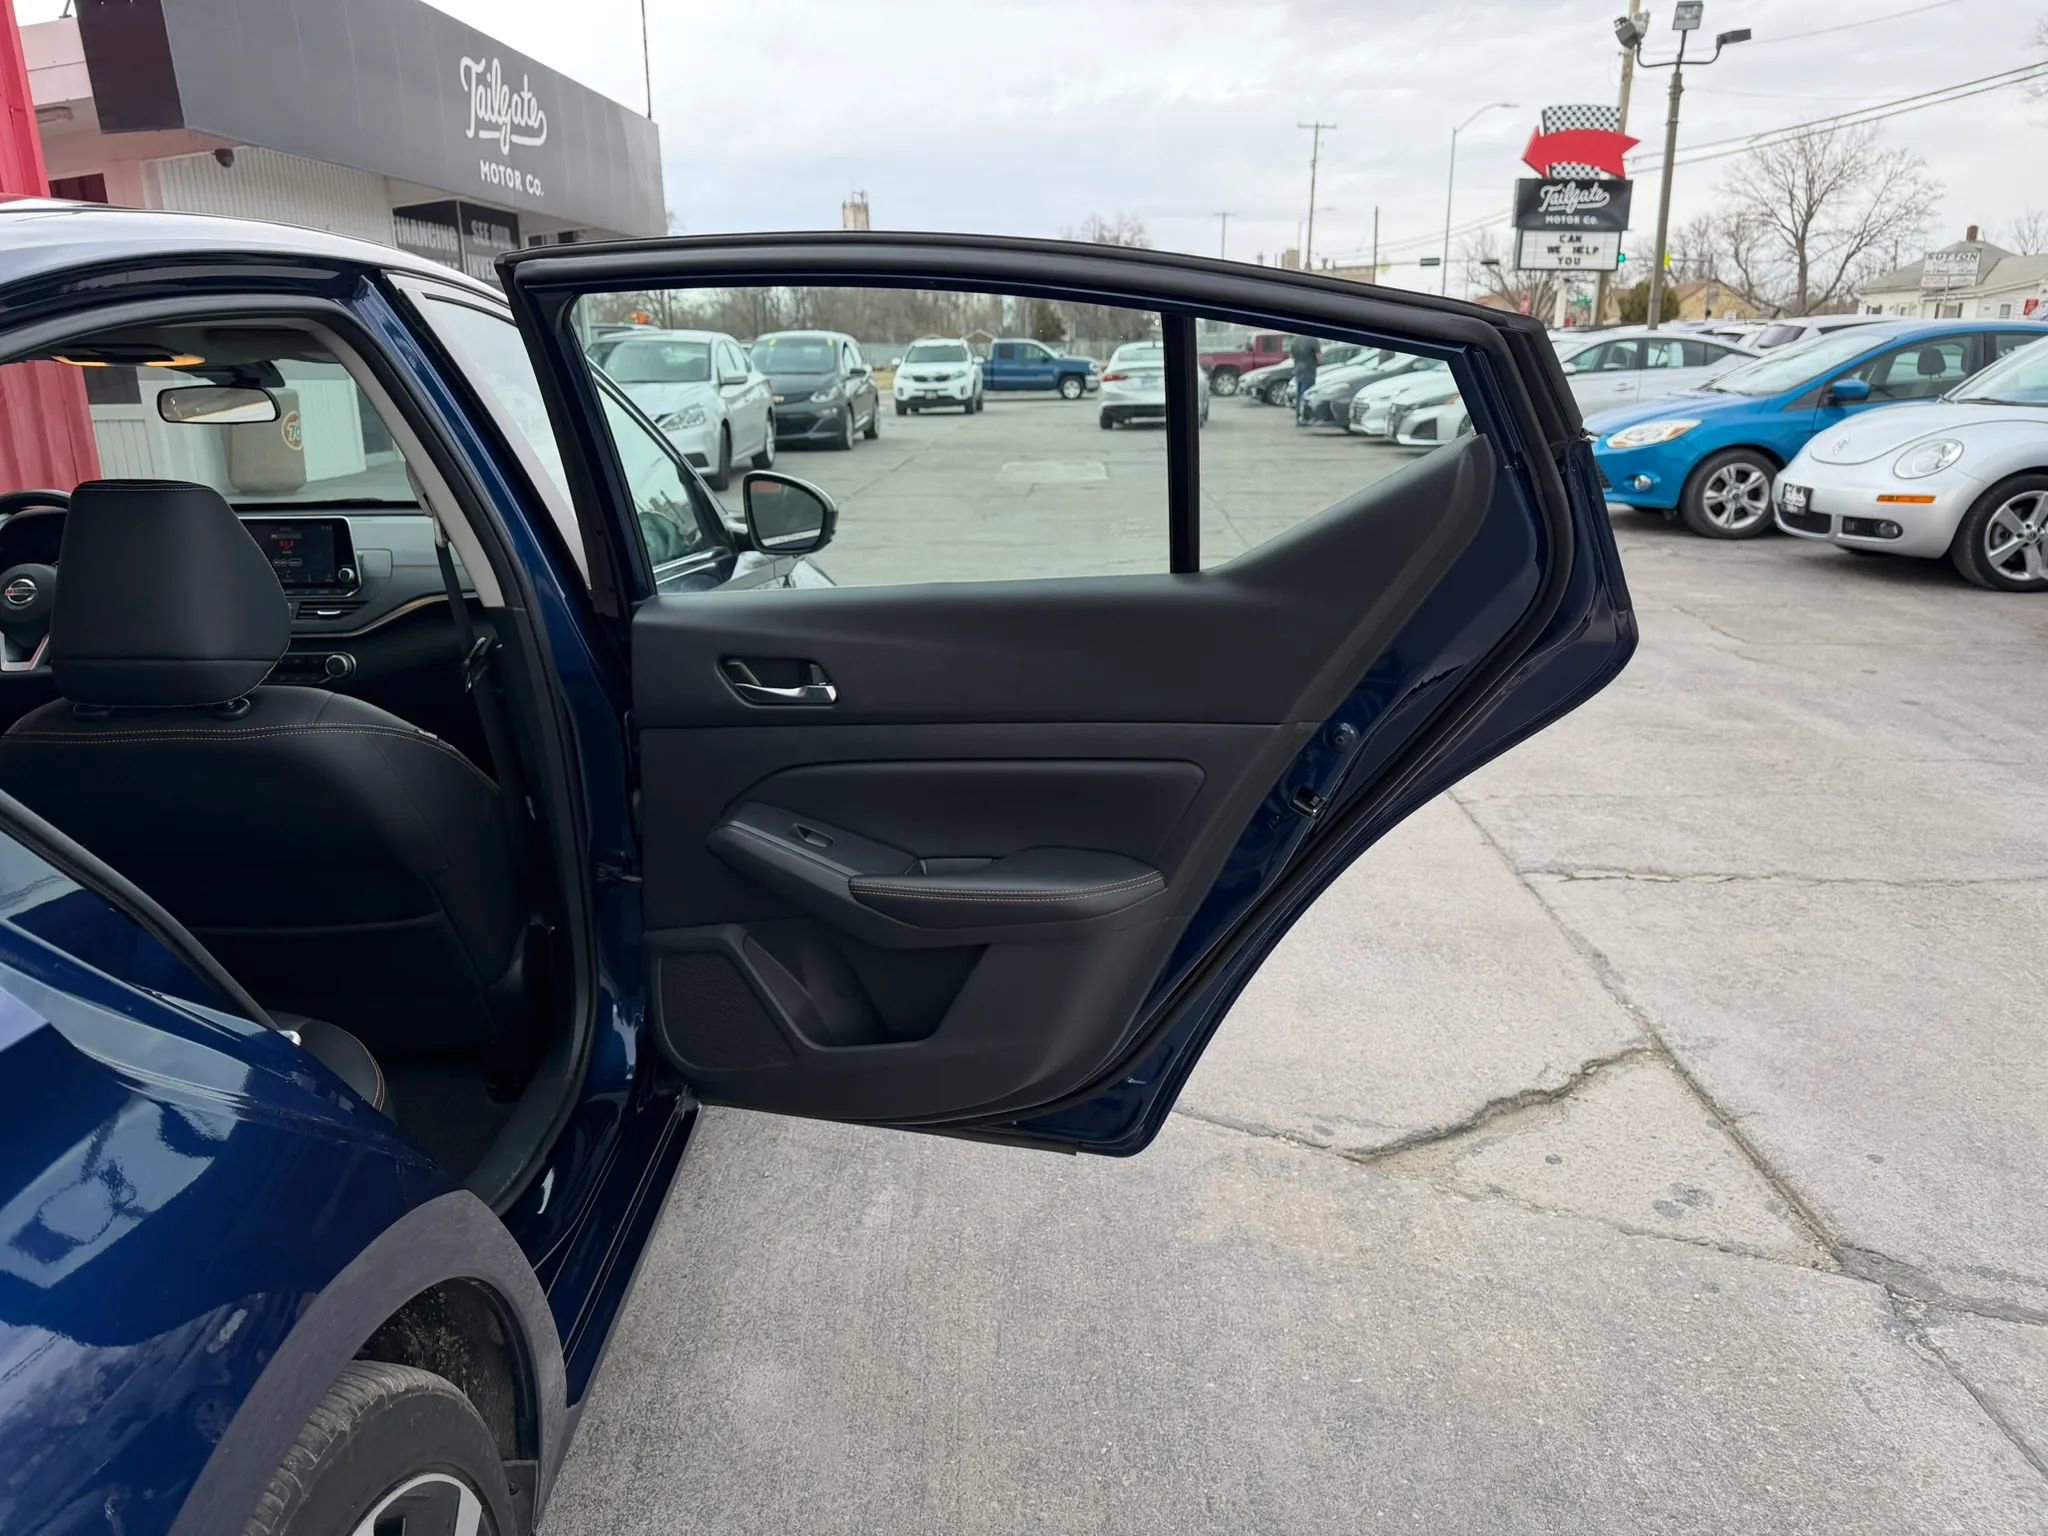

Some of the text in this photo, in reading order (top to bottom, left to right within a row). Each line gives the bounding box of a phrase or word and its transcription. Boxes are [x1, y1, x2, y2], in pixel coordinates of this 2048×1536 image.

[460, 56, 547, 155] Tailgate
[480, 160, 522, 191] MOTOR
[1538, 181, 1610, 214] Tailgate
[1545, 214, 1580, 225] MOTOR
[395, 215, 459, 252] INANCING
[1559, 234, 1582, 243] CAN
[1547, 245, 1599, 255] WE HELP
[1558, 256, 1581, 265] YOU
